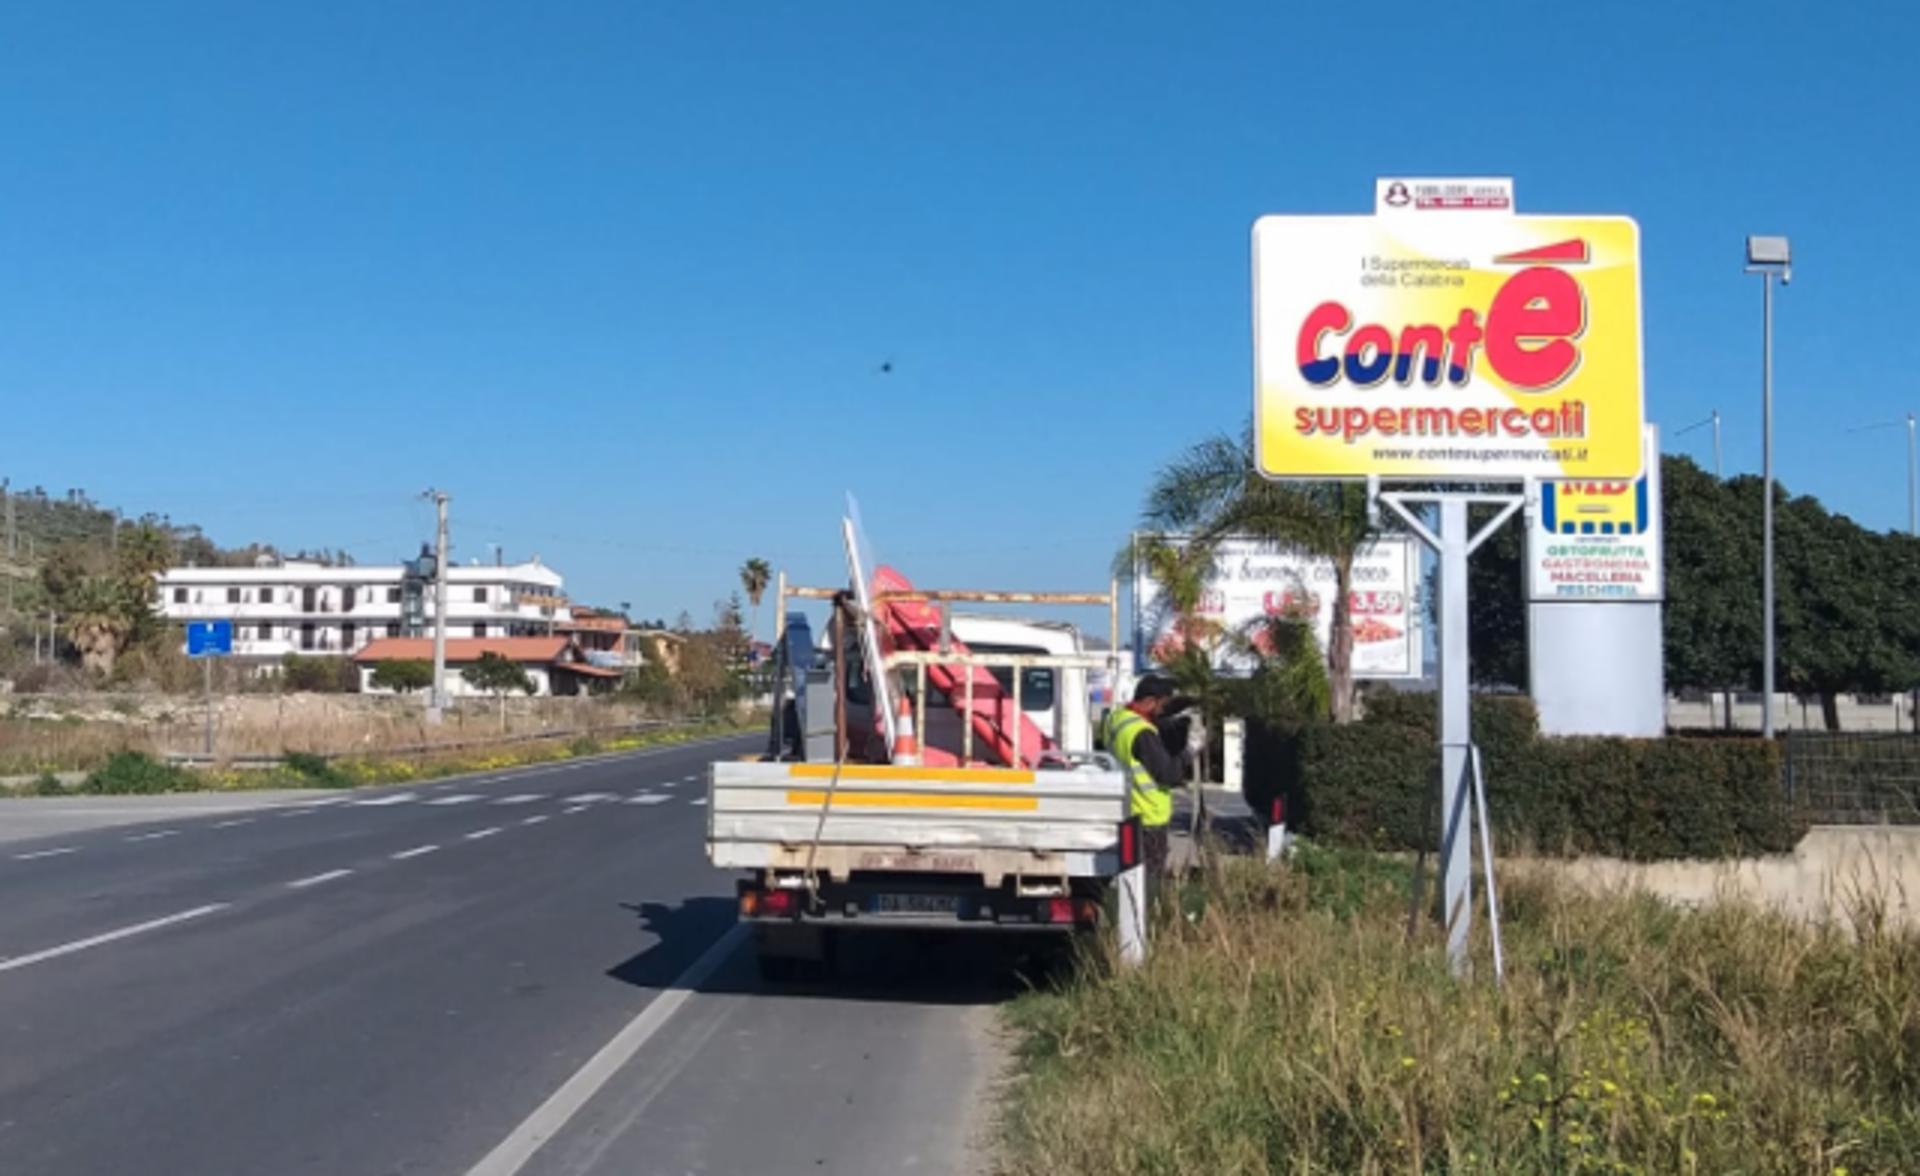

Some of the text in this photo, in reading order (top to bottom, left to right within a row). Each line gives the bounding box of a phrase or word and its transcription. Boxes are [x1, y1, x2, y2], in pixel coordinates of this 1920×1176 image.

[1361, 273, 1465, 287] della Calabria
[1295, 401, 1585, 441] supermercati
[1372, 446, 1588, 463] www.contesupermercati.it
[1546, 545, 1645, 556] ORTOFRUTTA
[1541, 558, 1650, 570] GASTRONOMIA
[1549, 571, 1643, 583] MACELLERIA
[1556, 584, 1638, 595] PESCHERIA
